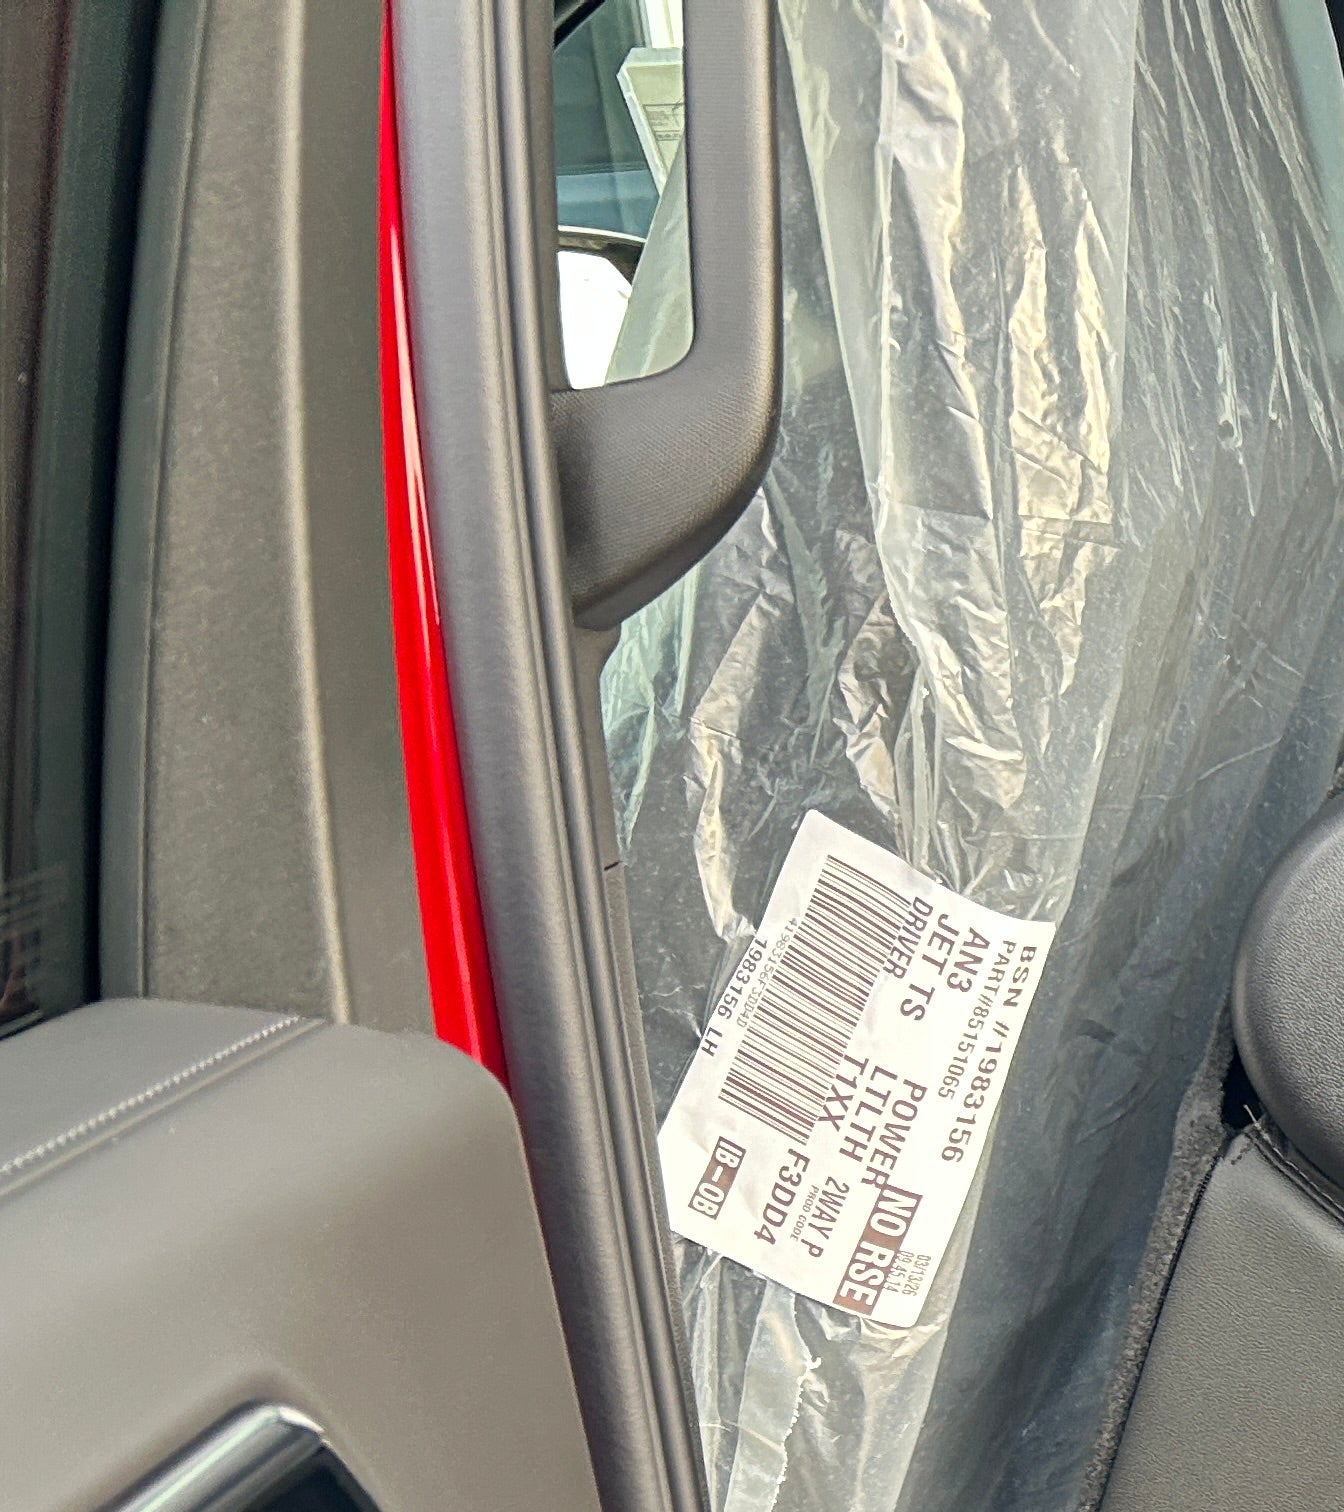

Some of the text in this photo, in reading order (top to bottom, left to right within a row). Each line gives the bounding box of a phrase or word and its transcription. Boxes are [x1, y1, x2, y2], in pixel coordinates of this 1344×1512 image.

[883, 896, 934, 979] DRIVER
[900, 913, 960, 1021] JET TS
[947, 927, 990, 993] AN3
[701, 938, 768, 1057] 1983156 LH
[938, 940, 1017, 1100] PART#85151065
[817, 1055, 869, 1132] T1XX
[941, 945, 1037, 1163] BSN #1983156
[838, 1065, 898, 1162] LTLTH
[861, 1079, 928, 1189] POWER
[753, 1148, 811, 1245] F3DD4
[790, 1184, 820, 1242] PROD CODE
[800, 1176, 850, 1258] 2WAY P
[839, 1189, 919, 1307] NO RSE
